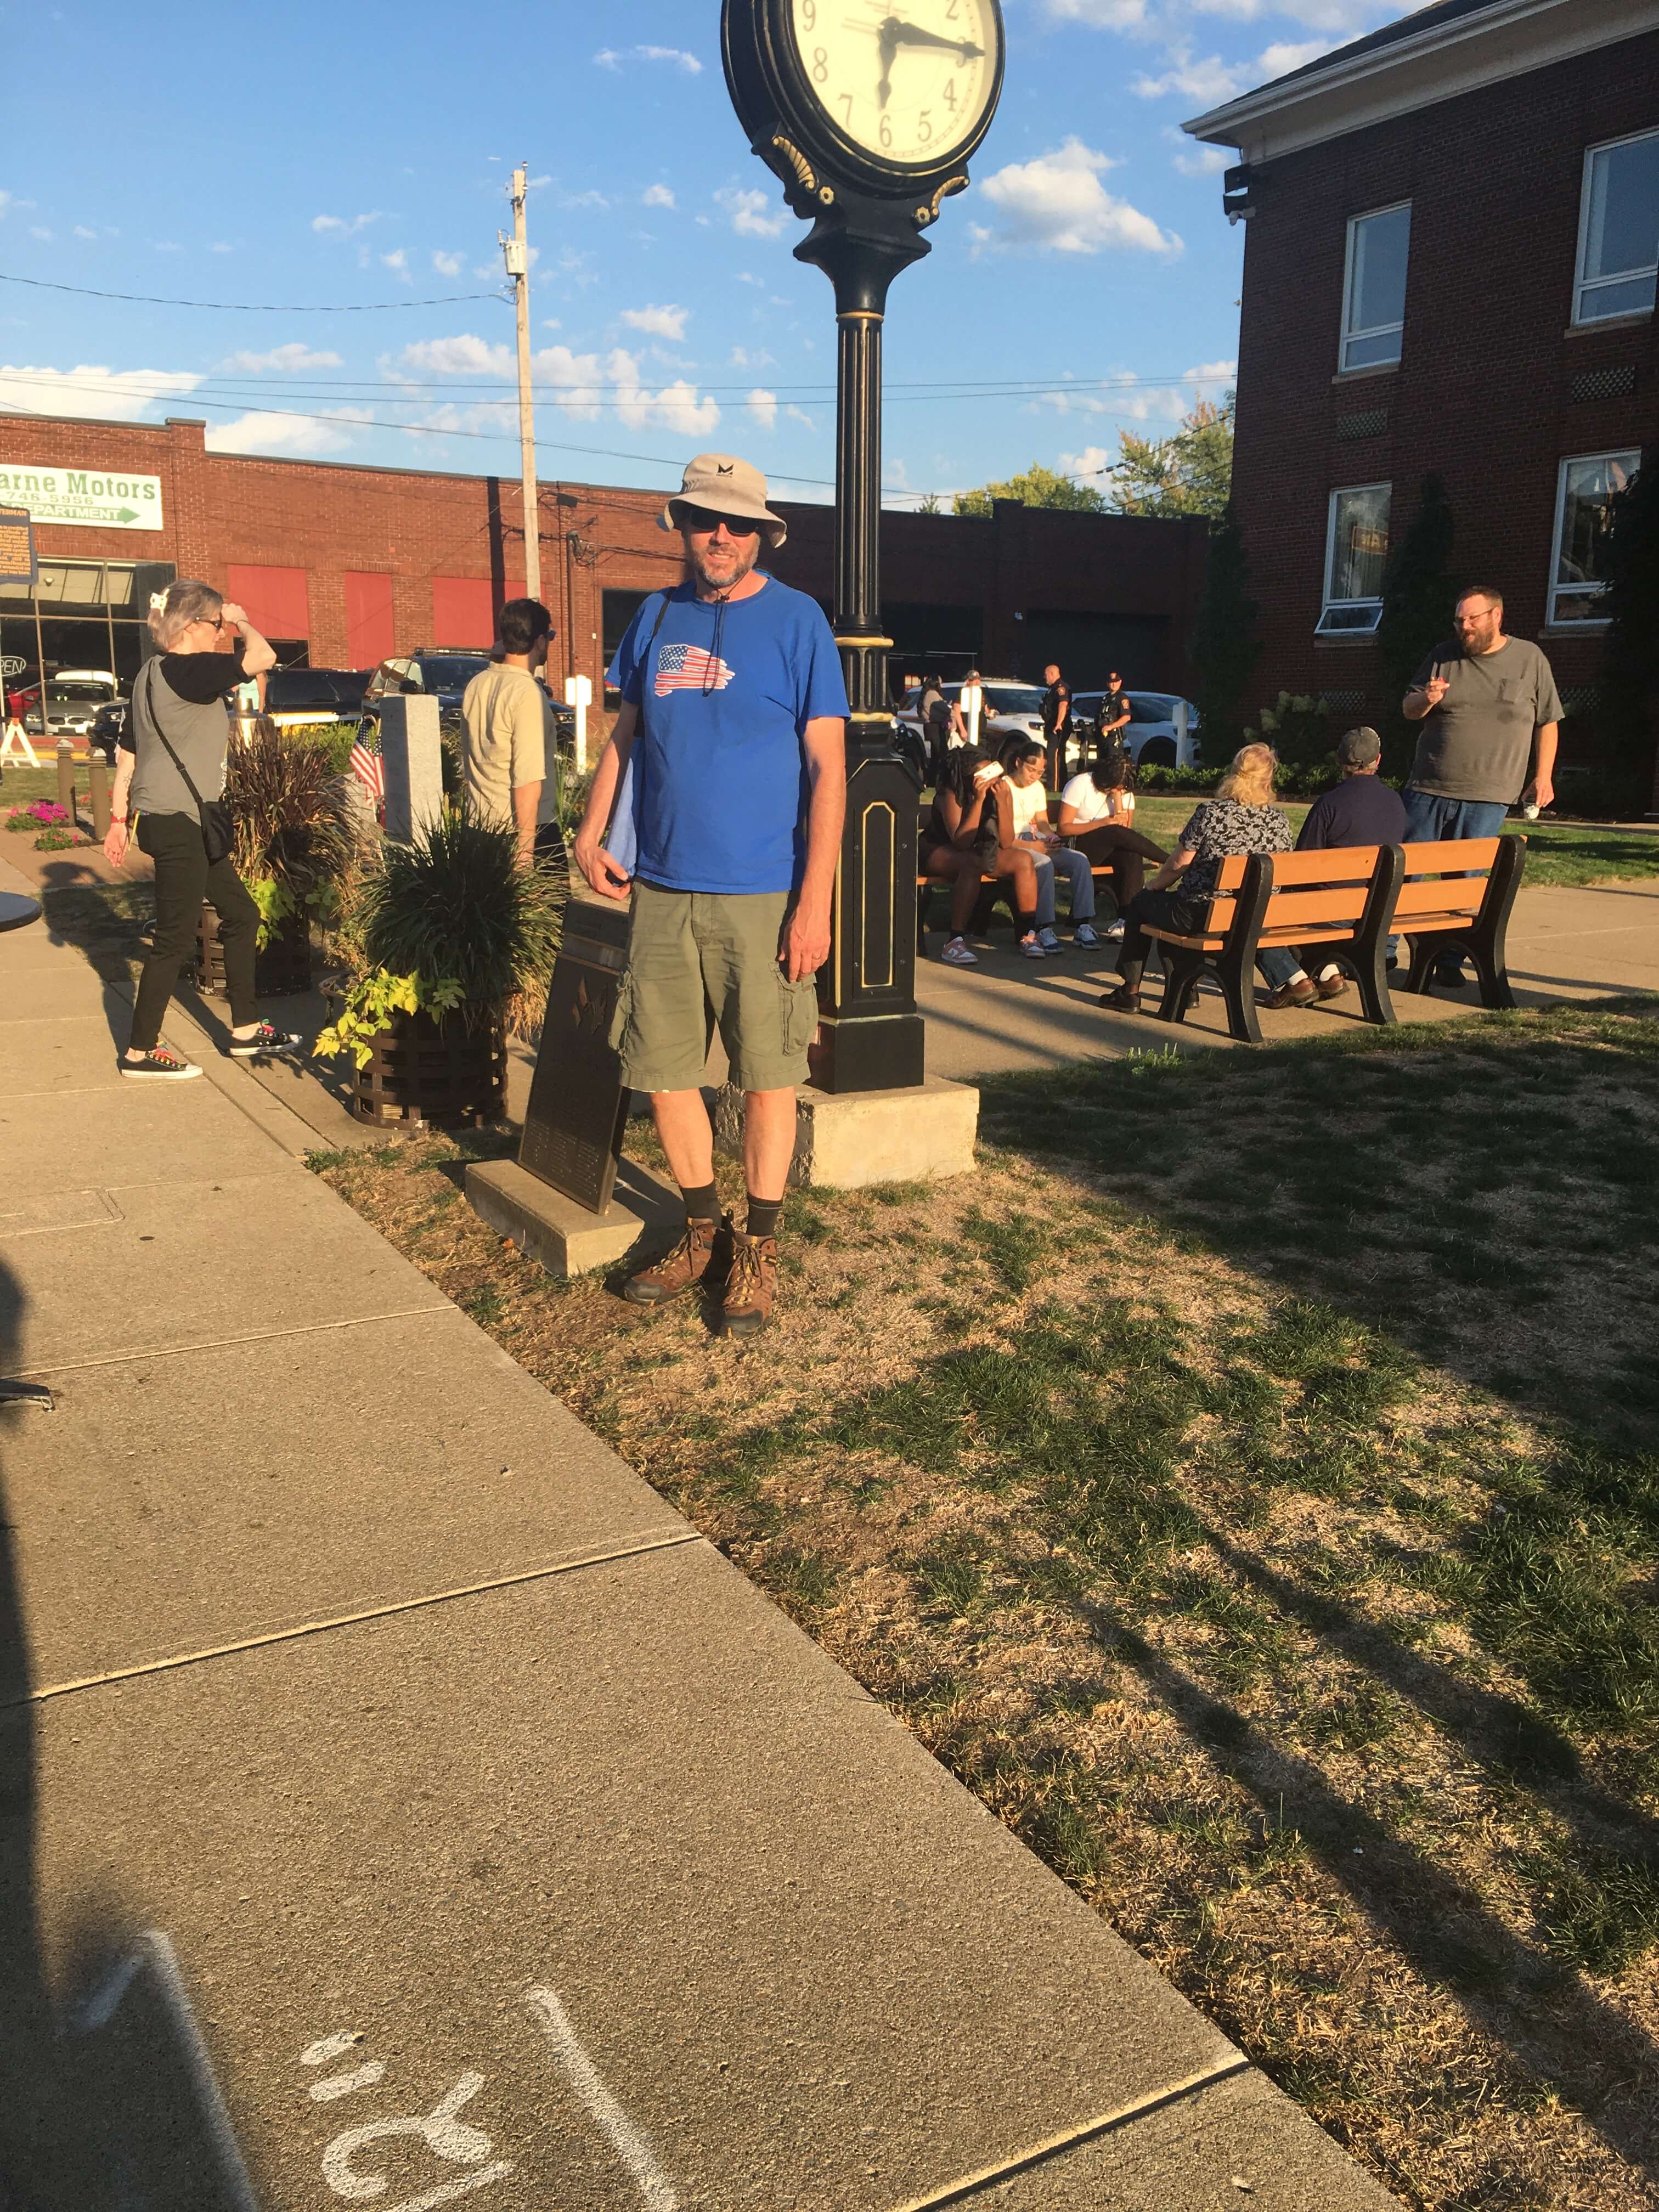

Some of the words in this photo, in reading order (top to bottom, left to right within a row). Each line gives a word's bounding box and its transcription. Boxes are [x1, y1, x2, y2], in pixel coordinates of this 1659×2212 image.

[813, 47, 828, 83] 8
[837, 93, 853, 129] 7
[943, 78, 957, 112] 4
[879, 115, 893, 148] 6
[917, 109, 933, 143] 5
[66, 473, 155, 500] Motors
